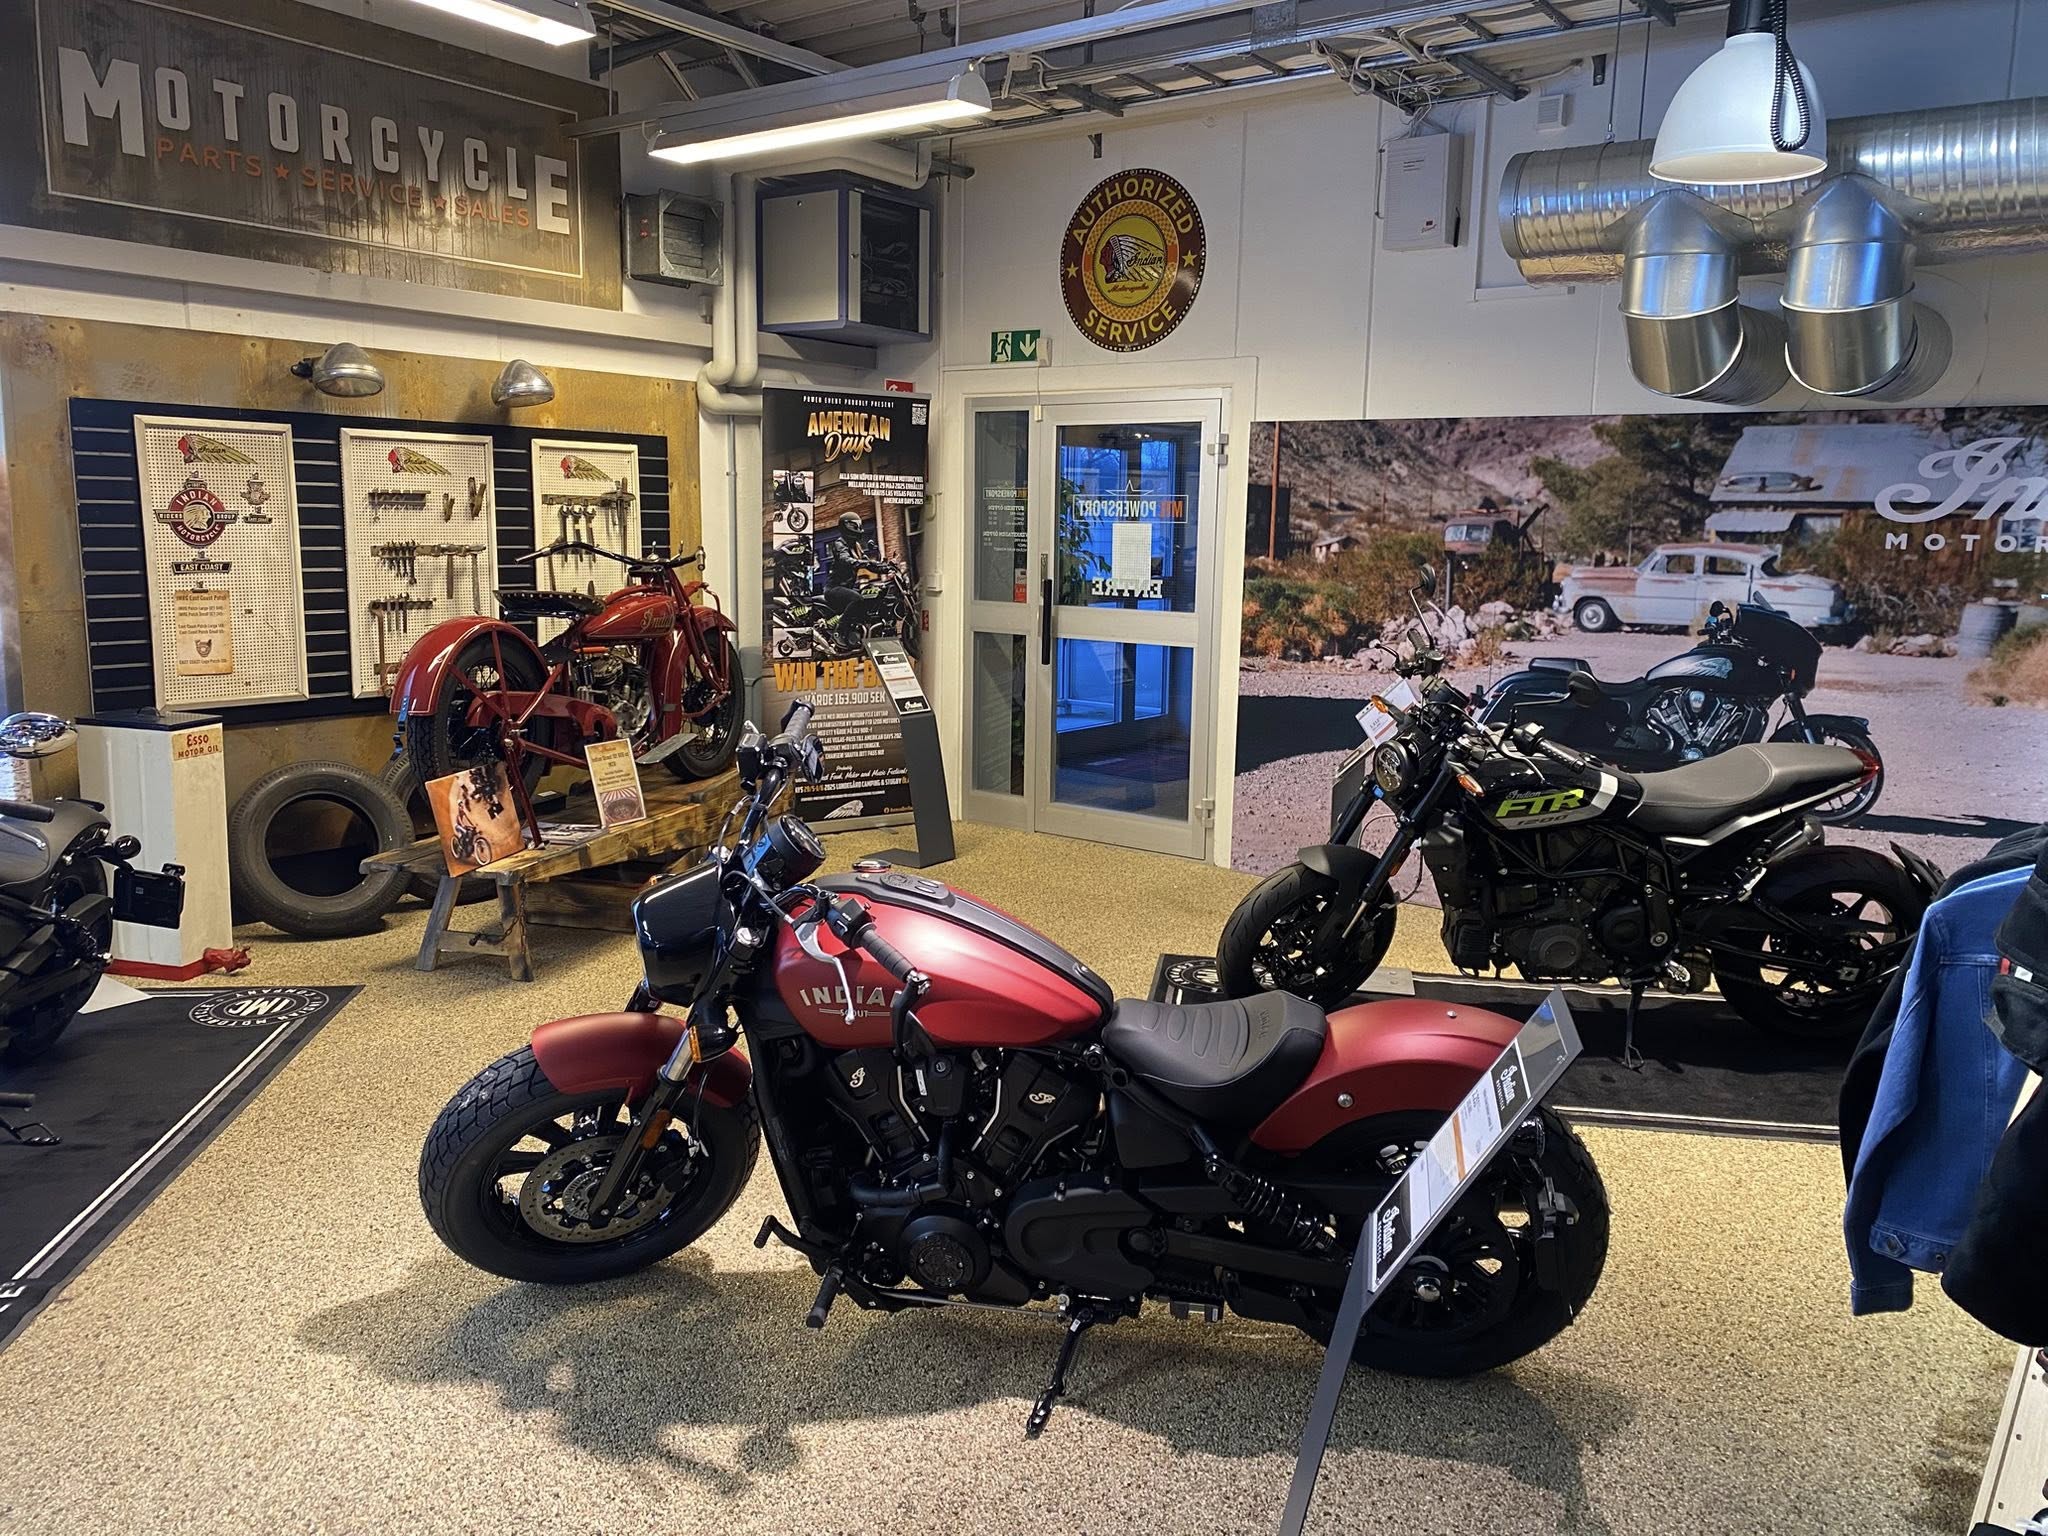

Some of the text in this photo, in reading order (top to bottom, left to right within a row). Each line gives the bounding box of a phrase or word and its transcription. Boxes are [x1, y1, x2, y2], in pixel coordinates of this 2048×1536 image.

[57, 46, 570, 235] MOTORCYCLE
[156, 137, 530, 227] PARTS SERVICE SALES
[1073, 178, 1193, 245] AUTHORIZED
[1127, 252, 1163, 267] Indian
[1084, 300, 1176, 342] SERVICE
[844, 399, 868, 407] PROUDLY
[871, 400, 894, 408] PRESENT
[807, 411, 890, 442] AMERICAN
[824, 431, 874, 462] Days
[176, 491, 216, 505] INDIAN
[177, 524, 221, 541] MOTORCYCLE
[180, 563, 223, 571] EAST COAST
[773, 661, 816, 692] WIN
[823, 657, 859, 690] THE
[804, 691, 886, 706] VÄRDE 163.900 SEK
[178, 747, 204, 758] MOTOR
[1495, 788, 1584, 818] FTR
[1506, 790, 1541, 800] Indian
[228, 997, 291, 1017] IMC
[840, 1009, 868, 1017] SOUT
[1501, 1065, 1518, 1106] Indian
[1382, 1206, 1400, 1259] Indian
